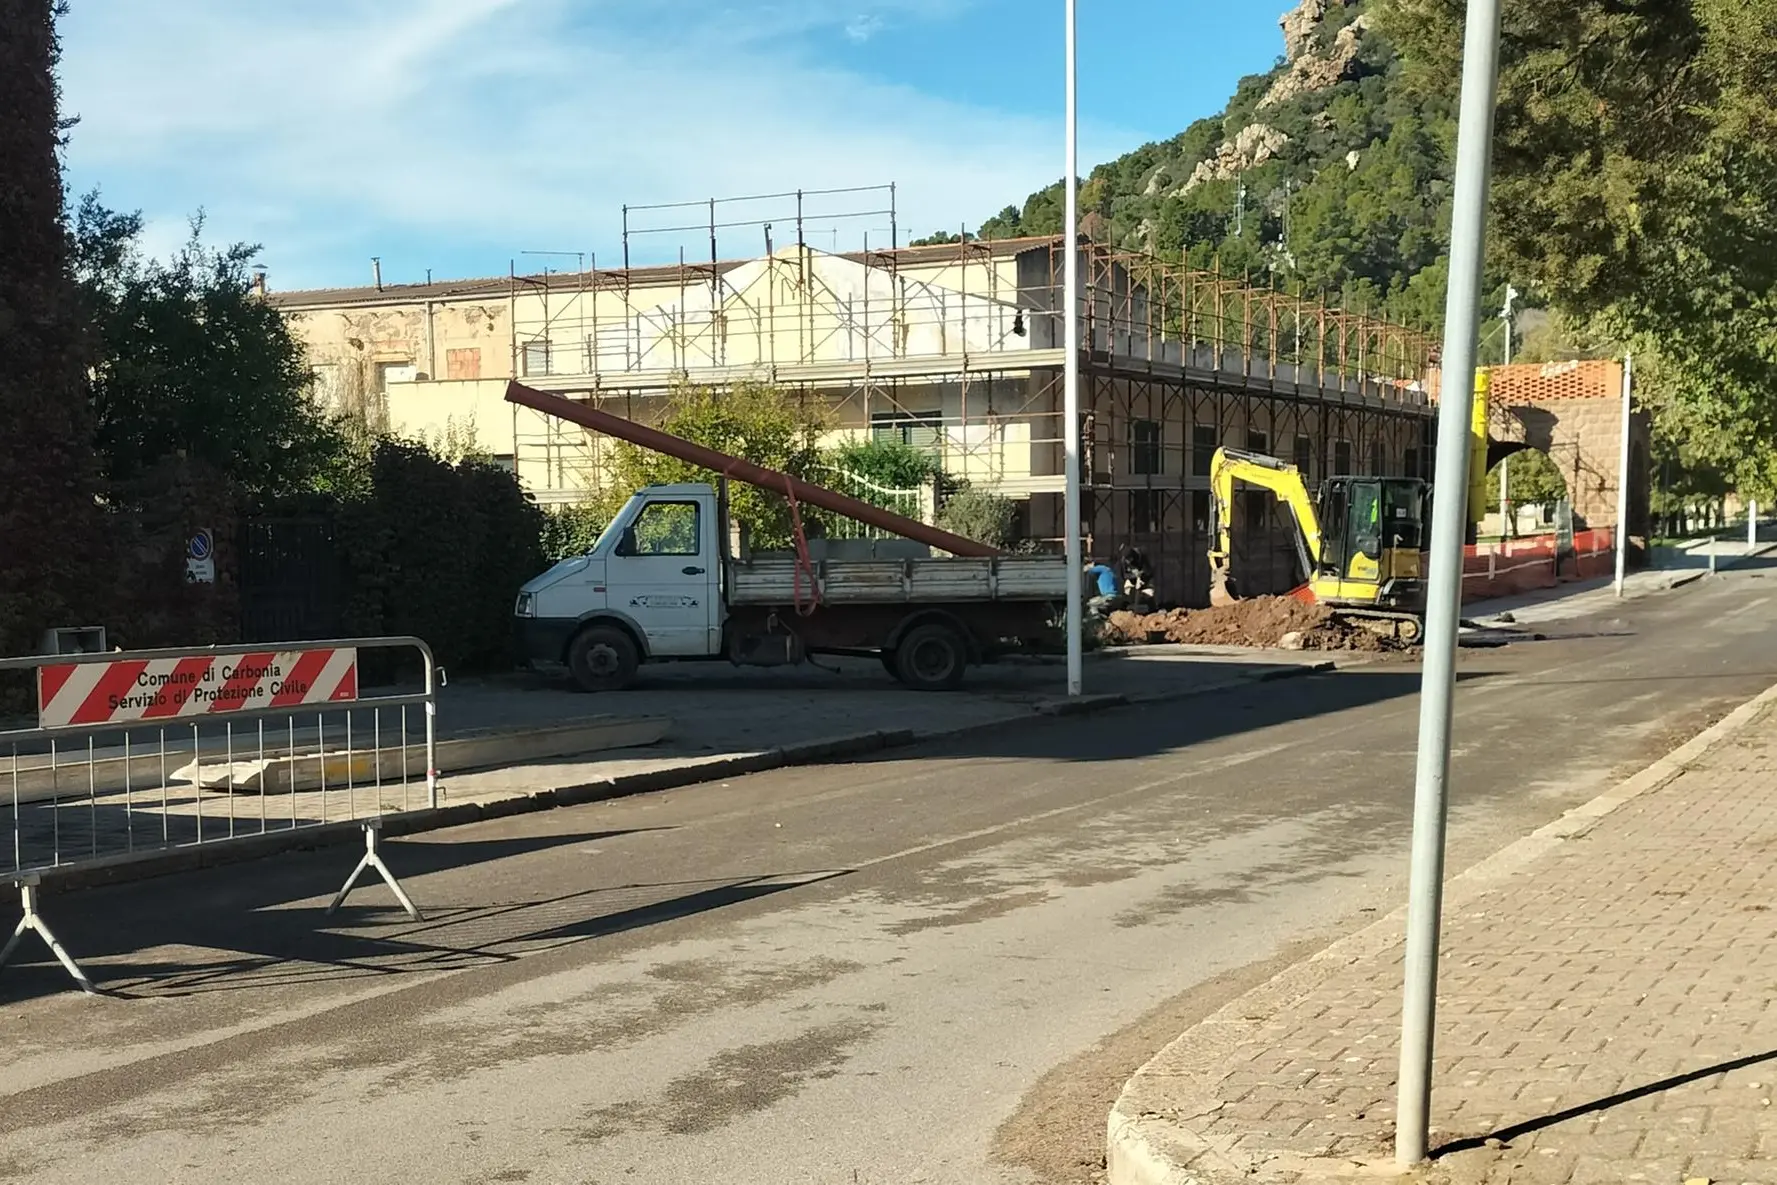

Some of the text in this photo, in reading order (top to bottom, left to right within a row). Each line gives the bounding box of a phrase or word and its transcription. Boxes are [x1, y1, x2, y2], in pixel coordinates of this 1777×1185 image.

[137, 663, 281, 687] Comune di Carbonia
[108, 679, 307, 710] Servizio di Protezione Civile
